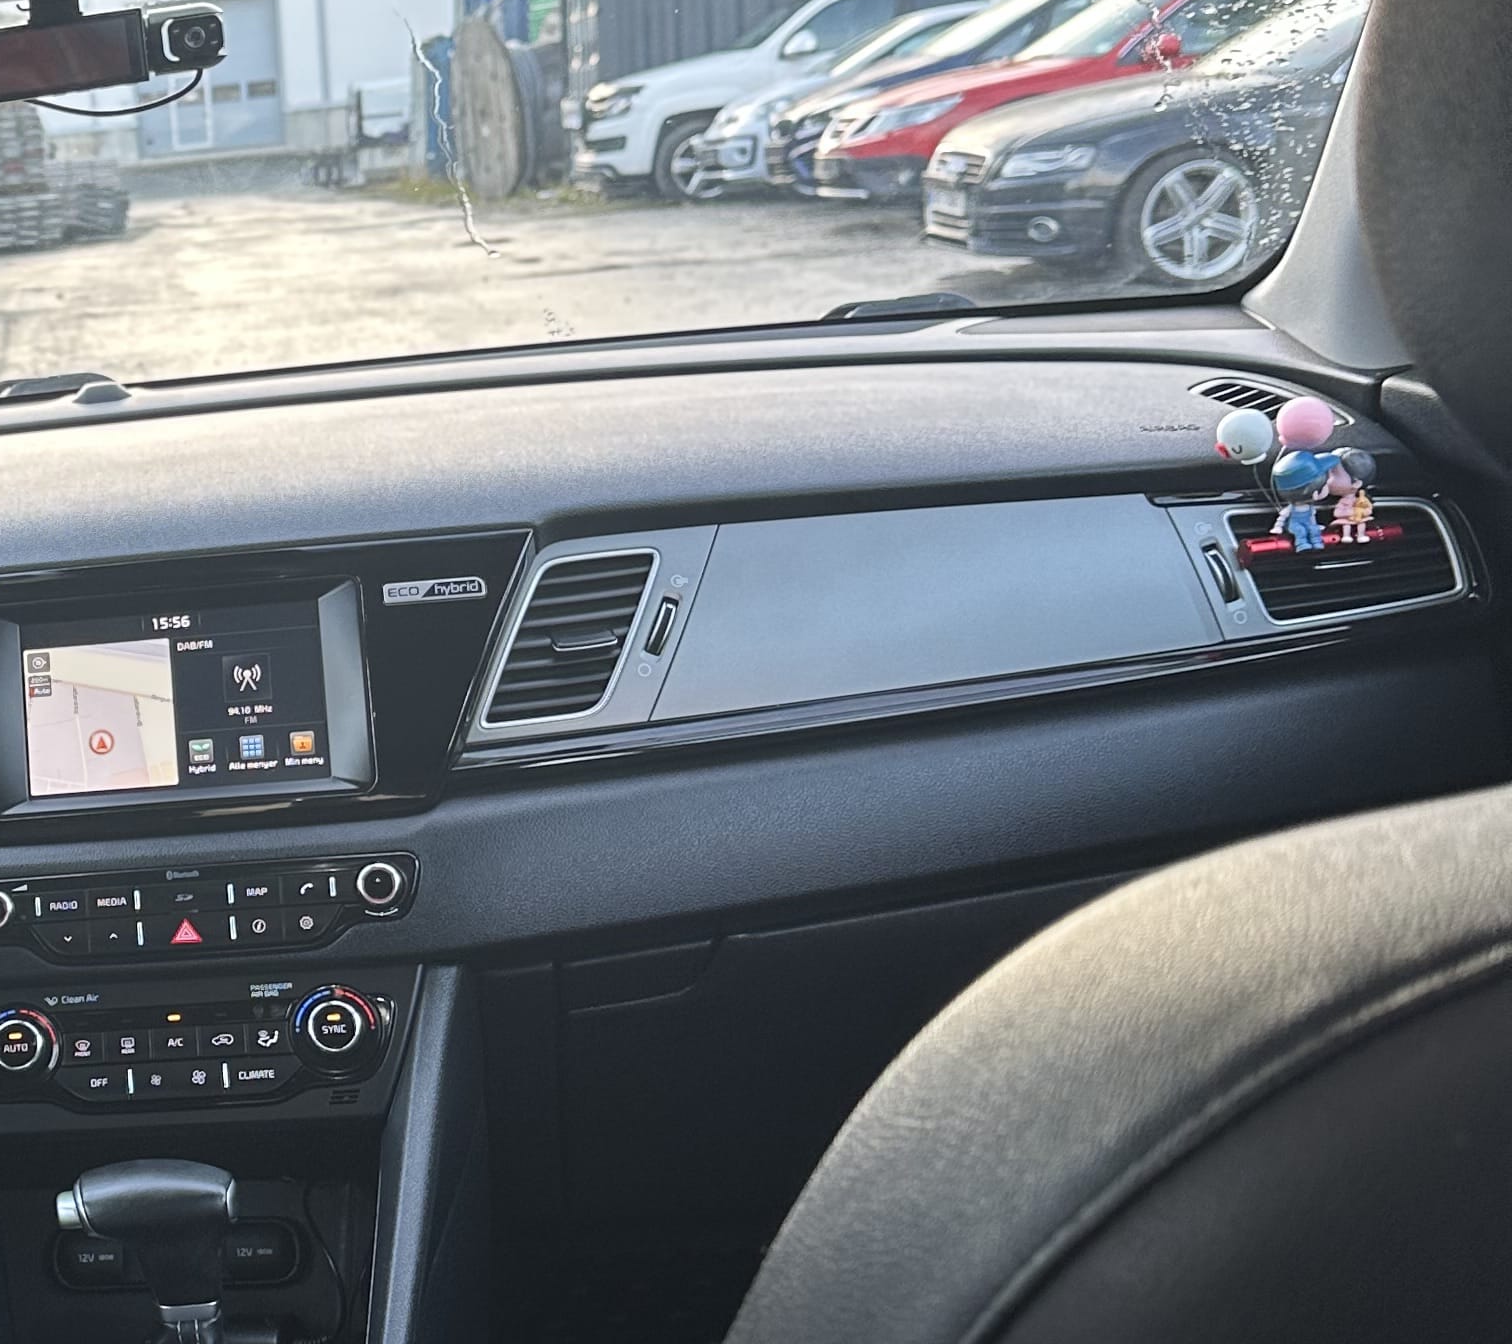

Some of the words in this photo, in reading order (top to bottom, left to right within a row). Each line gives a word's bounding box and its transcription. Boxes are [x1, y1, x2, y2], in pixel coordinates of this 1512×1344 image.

[388, 586, 420, 598] ECO
[434, 581, 479, 596] hybrid
[151, 615, 191, 631] 15:56
[176, 640, 213, 652] DAB/FM
[254, 705, 273, 714] MHz
[244, 716, 258, 725] FM
[188, 764, 217, 774] Hybrid
[246, 887, 268, 897] MAP
[49, 900, 78, 911] RADIO
[96, 896, 127, 907] MEDIA
[61, 995, 84, 1005] Clean
[86, 994, 100, 1003] Air
[321, 1024, 347, 1035] SYNC
[167, 1037, 184, 1048] A/C
[3, 1043, 29, 1054] AUTO
[238, 1069, 275, 1081] CLIMATE
[90, 1078, 109, 1088] OFF
[237, 1248, 253, 1257] 12V
[78, 1254, 95, 1263] 12V
